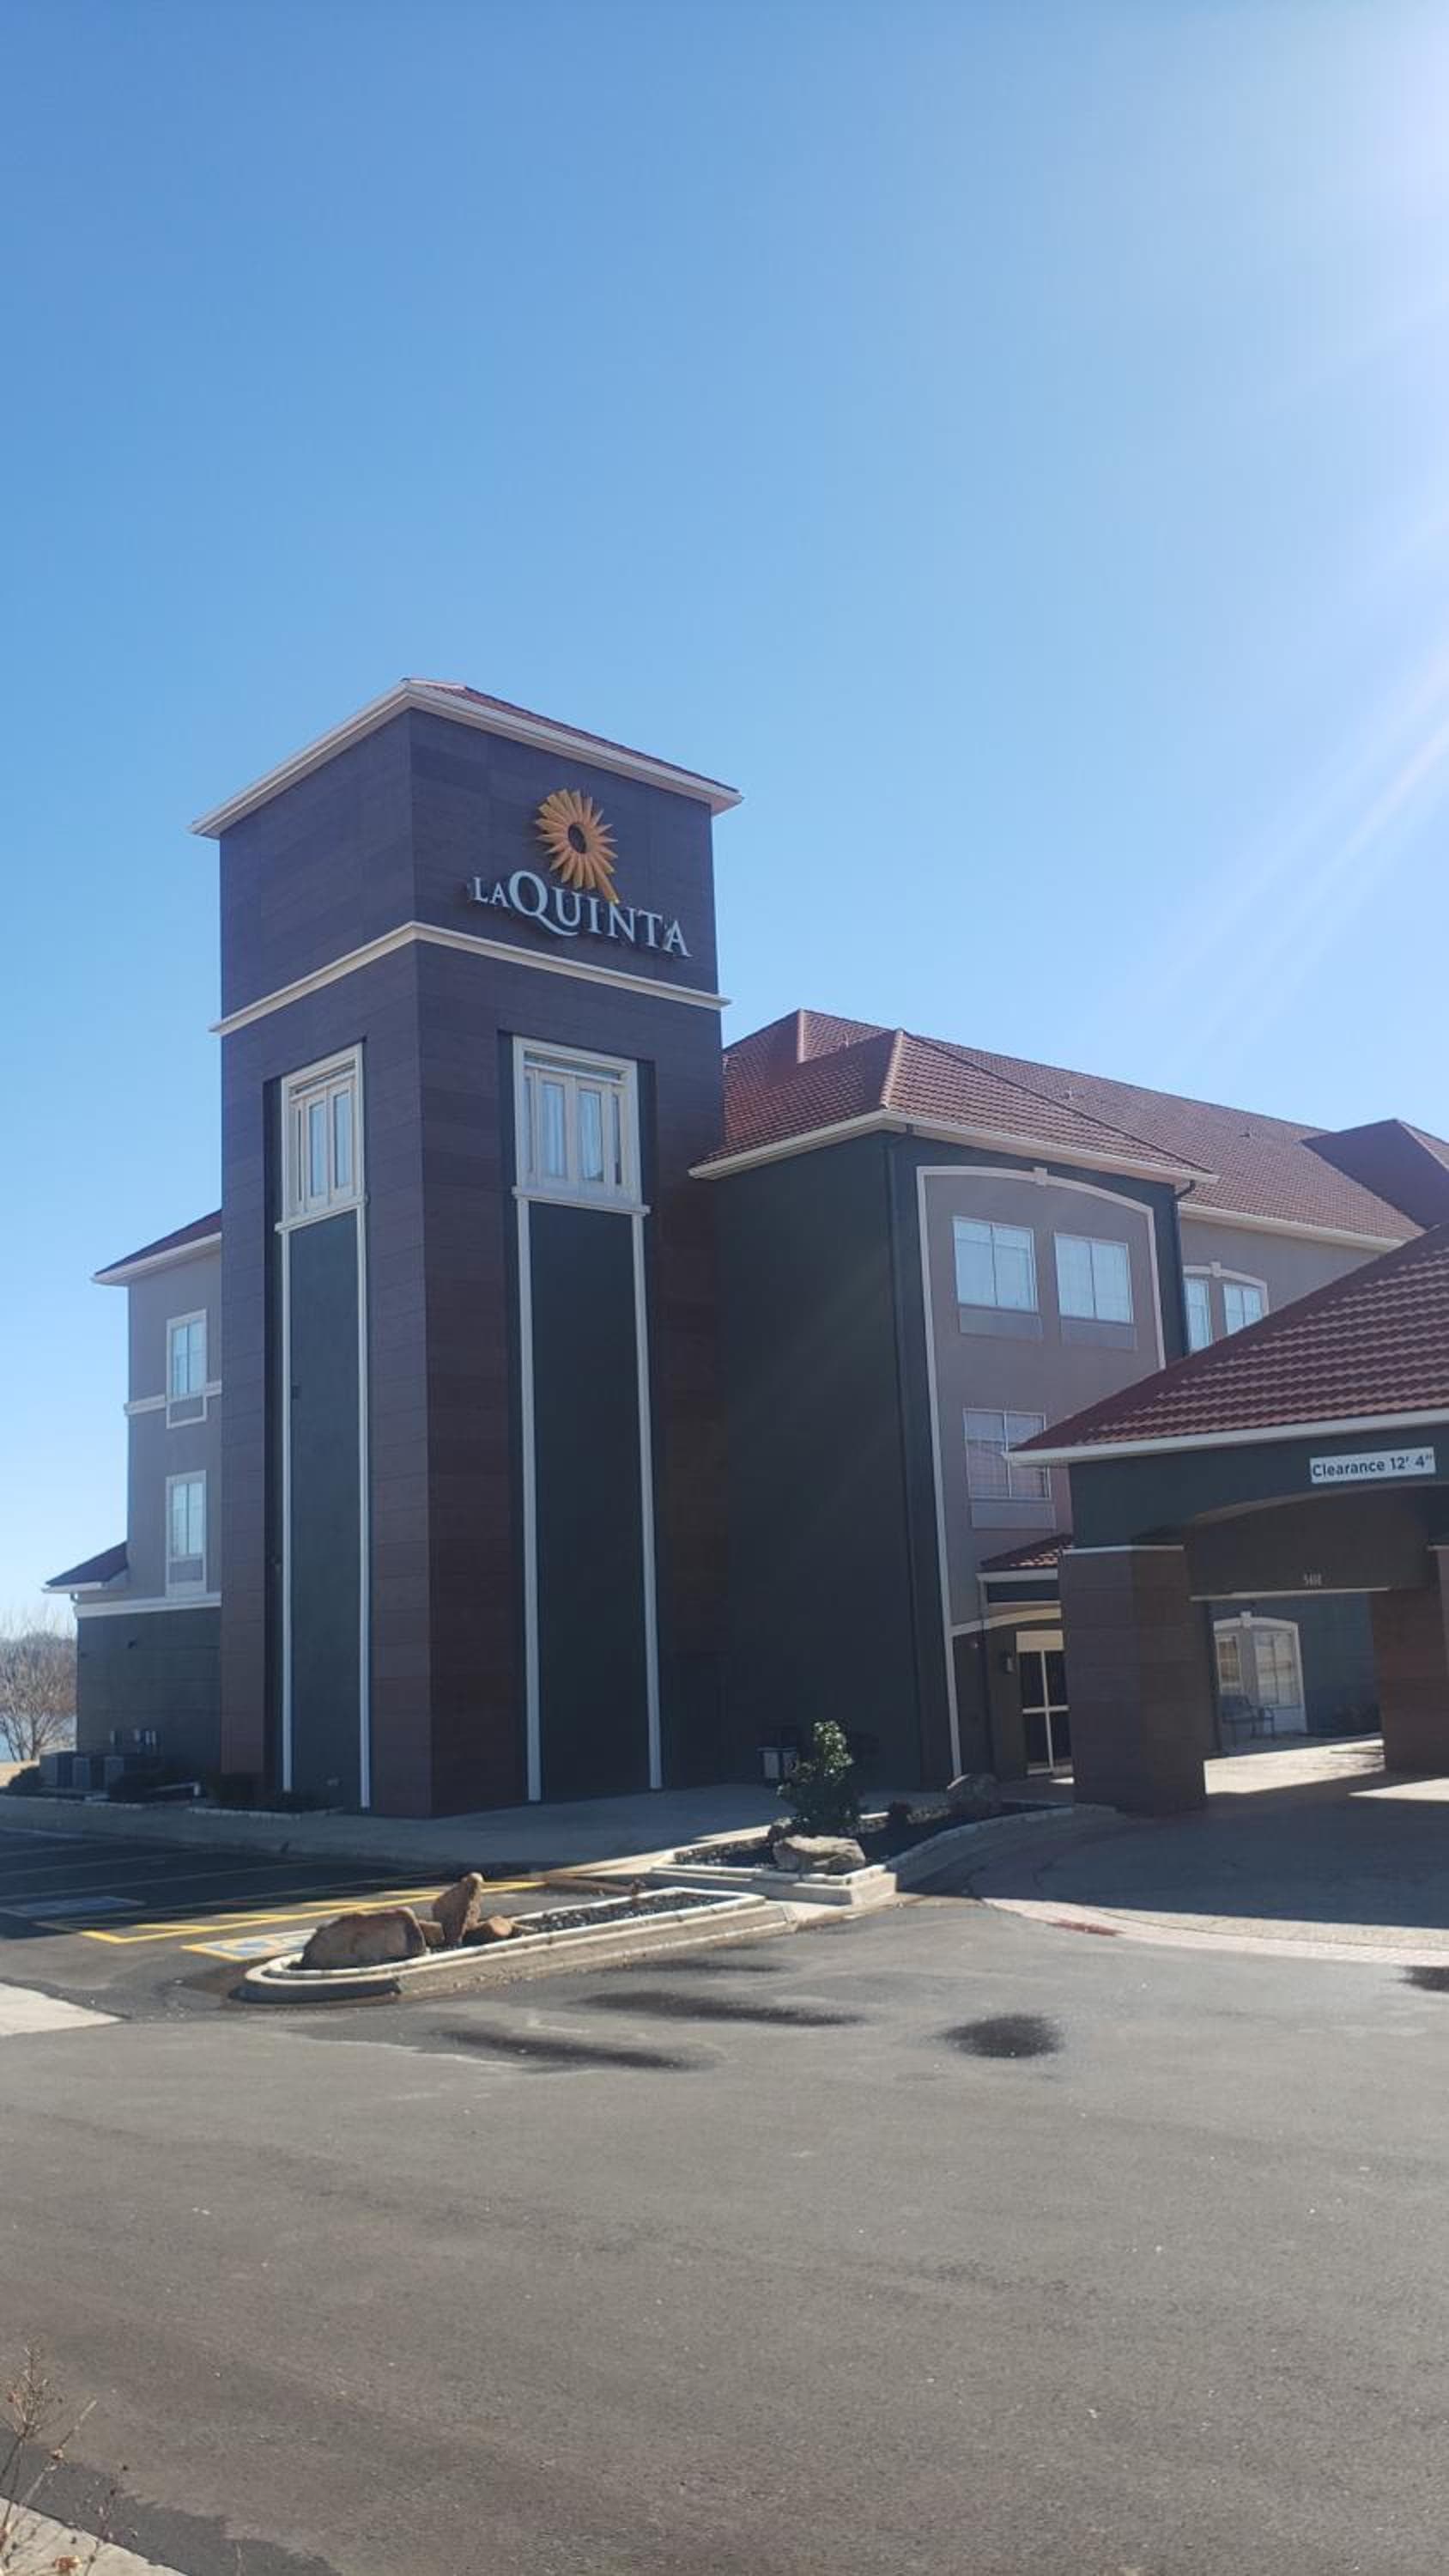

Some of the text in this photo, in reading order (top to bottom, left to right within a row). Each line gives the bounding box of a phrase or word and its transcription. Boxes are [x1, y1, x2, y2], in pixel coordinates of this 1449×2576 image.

[473, 870, 693, 957] LA QUINTA
[1313, 1461, 1385, 1477] Clearance
